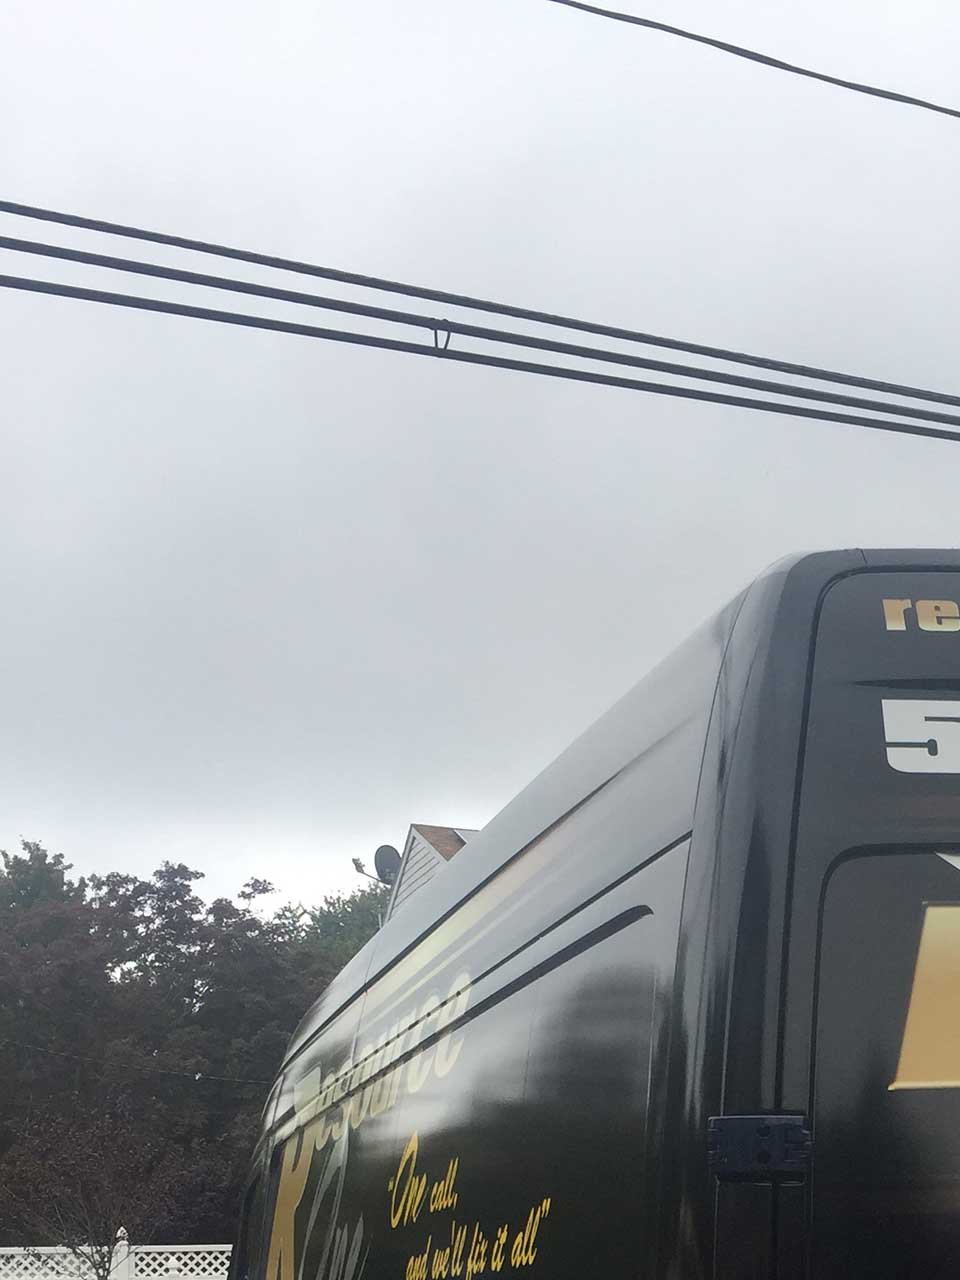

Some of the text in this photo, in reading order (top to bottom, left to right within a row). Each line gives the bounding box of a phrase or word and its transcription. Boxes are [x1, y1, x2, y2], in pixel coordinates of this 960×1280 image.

[430, 1156, 459, 1213] call,
[431, 1220, 467, 1278] we'll
[491, 1223, 509, 1272] it
